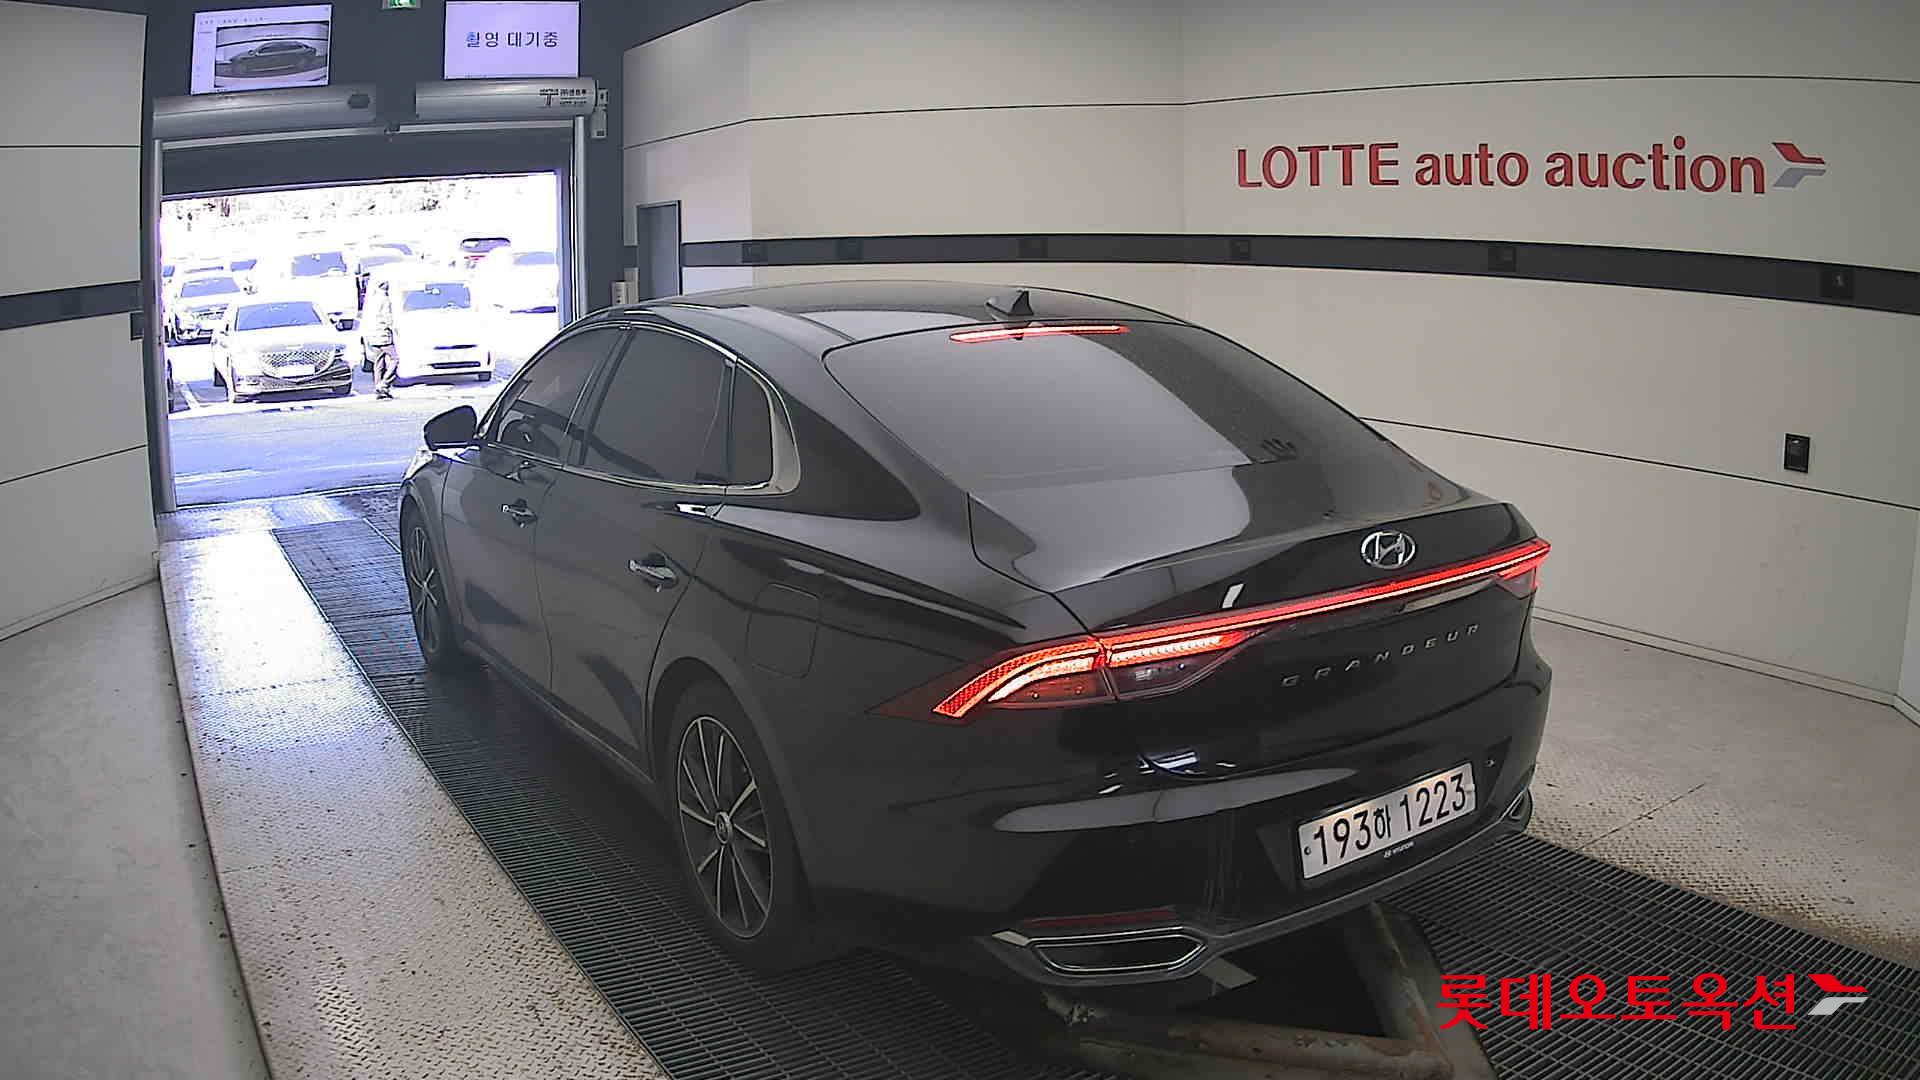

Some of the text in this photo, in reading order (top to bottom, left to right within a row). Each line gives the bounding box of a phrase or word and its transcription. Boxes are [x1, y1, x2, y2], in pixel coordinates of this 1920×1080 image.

[507, 31, 559, 48] 대기중
[1238, 136, 1765, 194] LOTTE auto auction
[1281, 624, 1479, 687] GRANDEUR
[1314, 773, 1466, 865] 193하 1223
